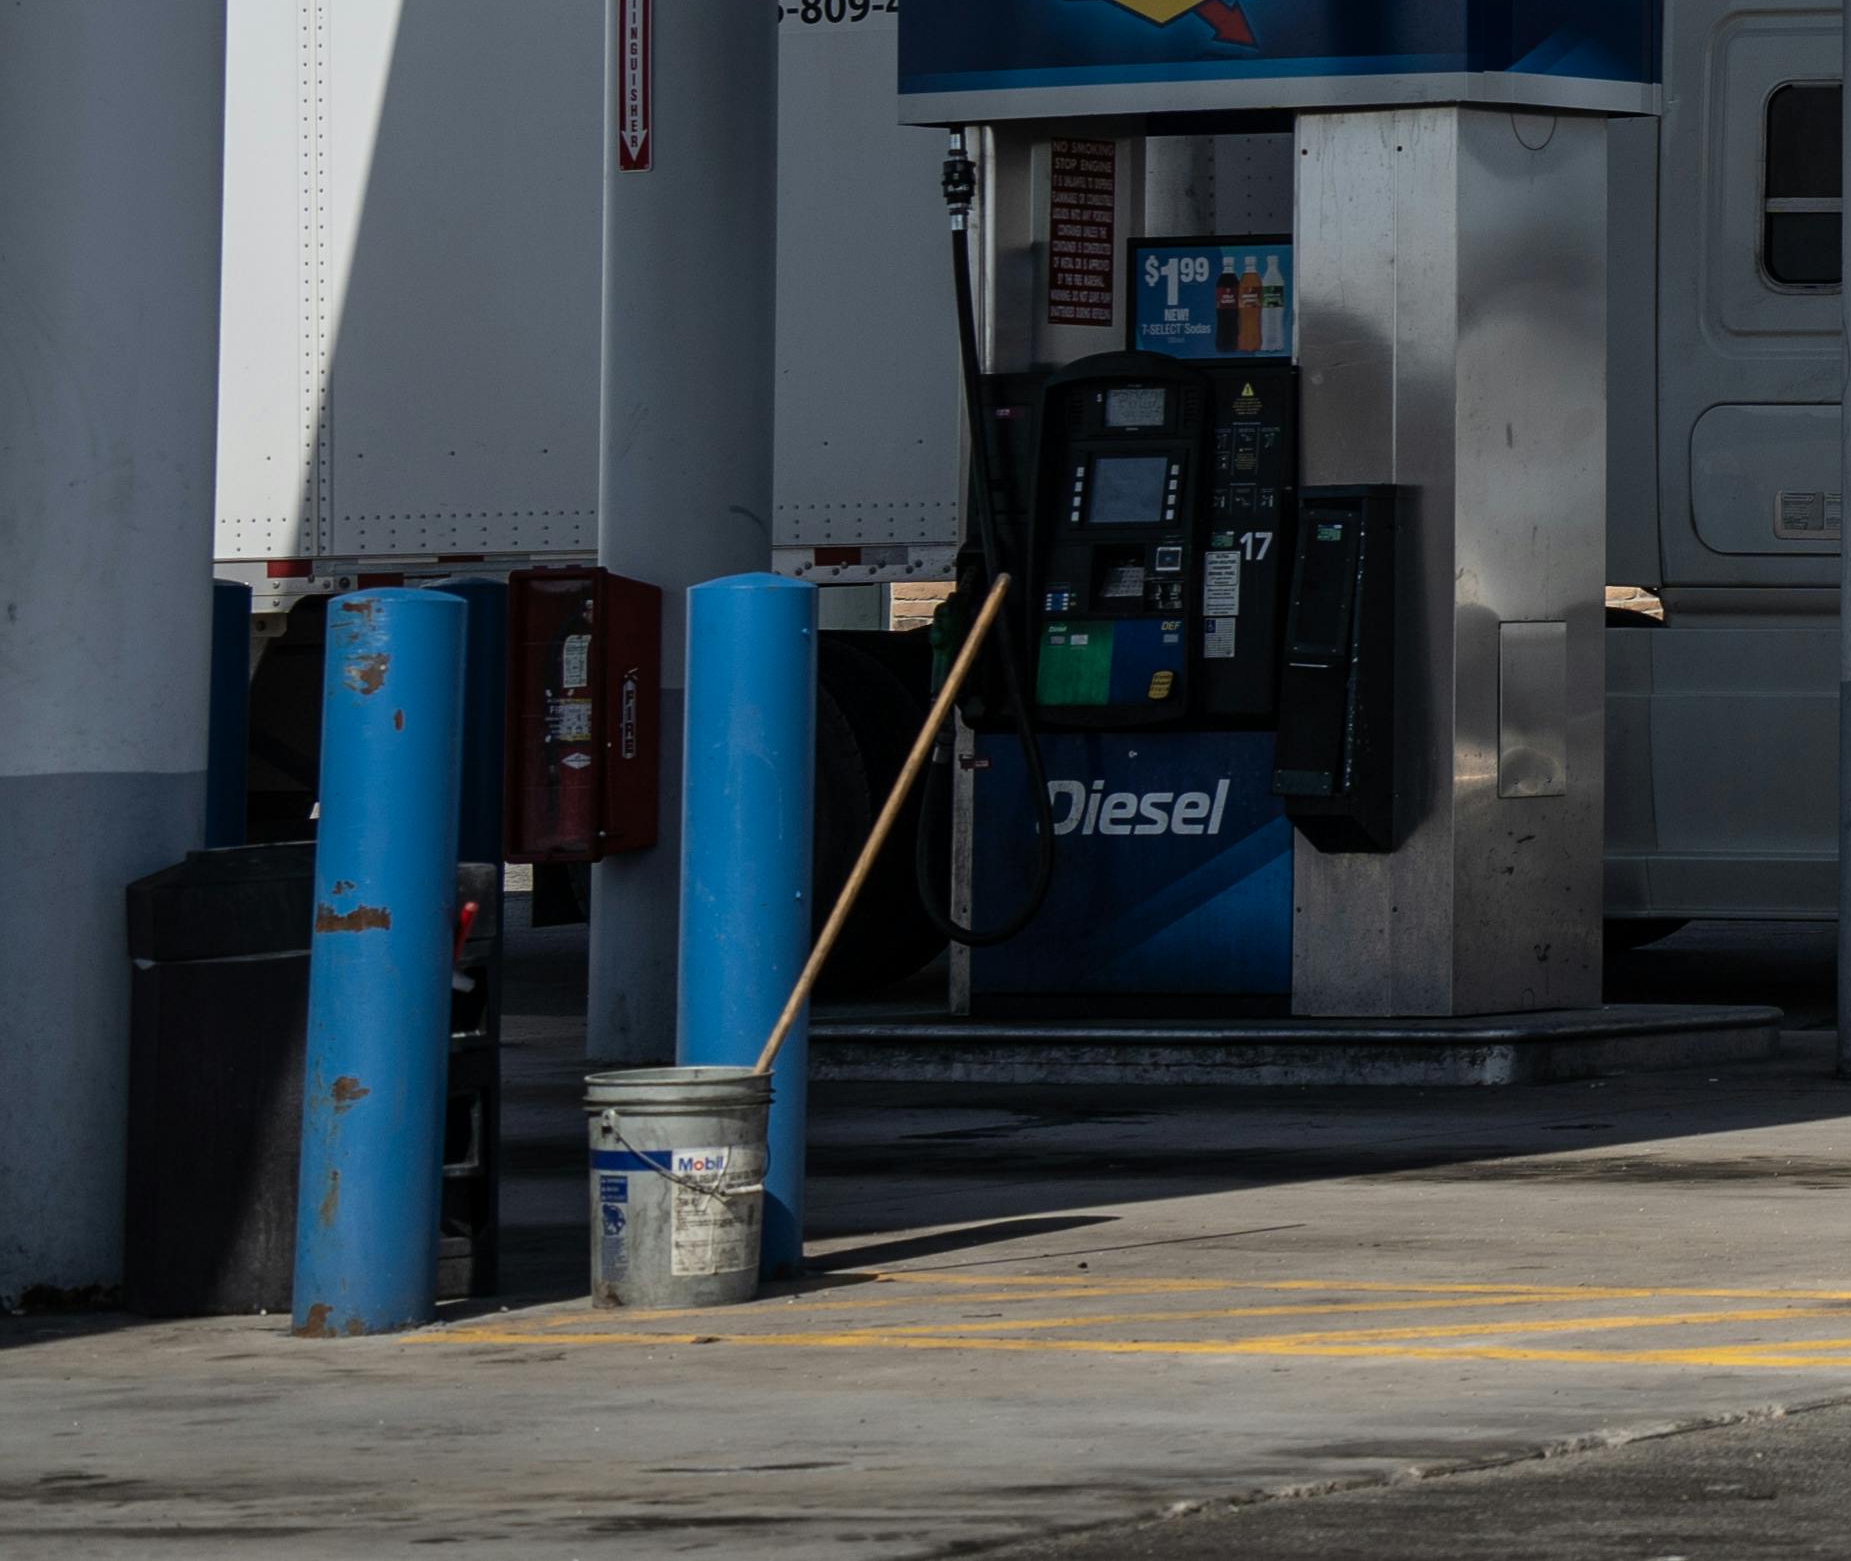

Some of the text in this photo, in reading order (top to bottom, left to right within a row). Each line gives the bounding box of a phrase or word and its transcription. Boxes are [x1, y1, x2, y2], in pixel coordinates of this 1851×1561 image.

[1164, 308, 1190, 322] NEW!
[1239, 531, 1273, 561] 17
[1160, 620, 1183, 631] DEF
[625, 689, 634, 754] FIRE
[1037, 779, 1231, 835] Diesel
[678, 1155, 724, 1172] Mobil
